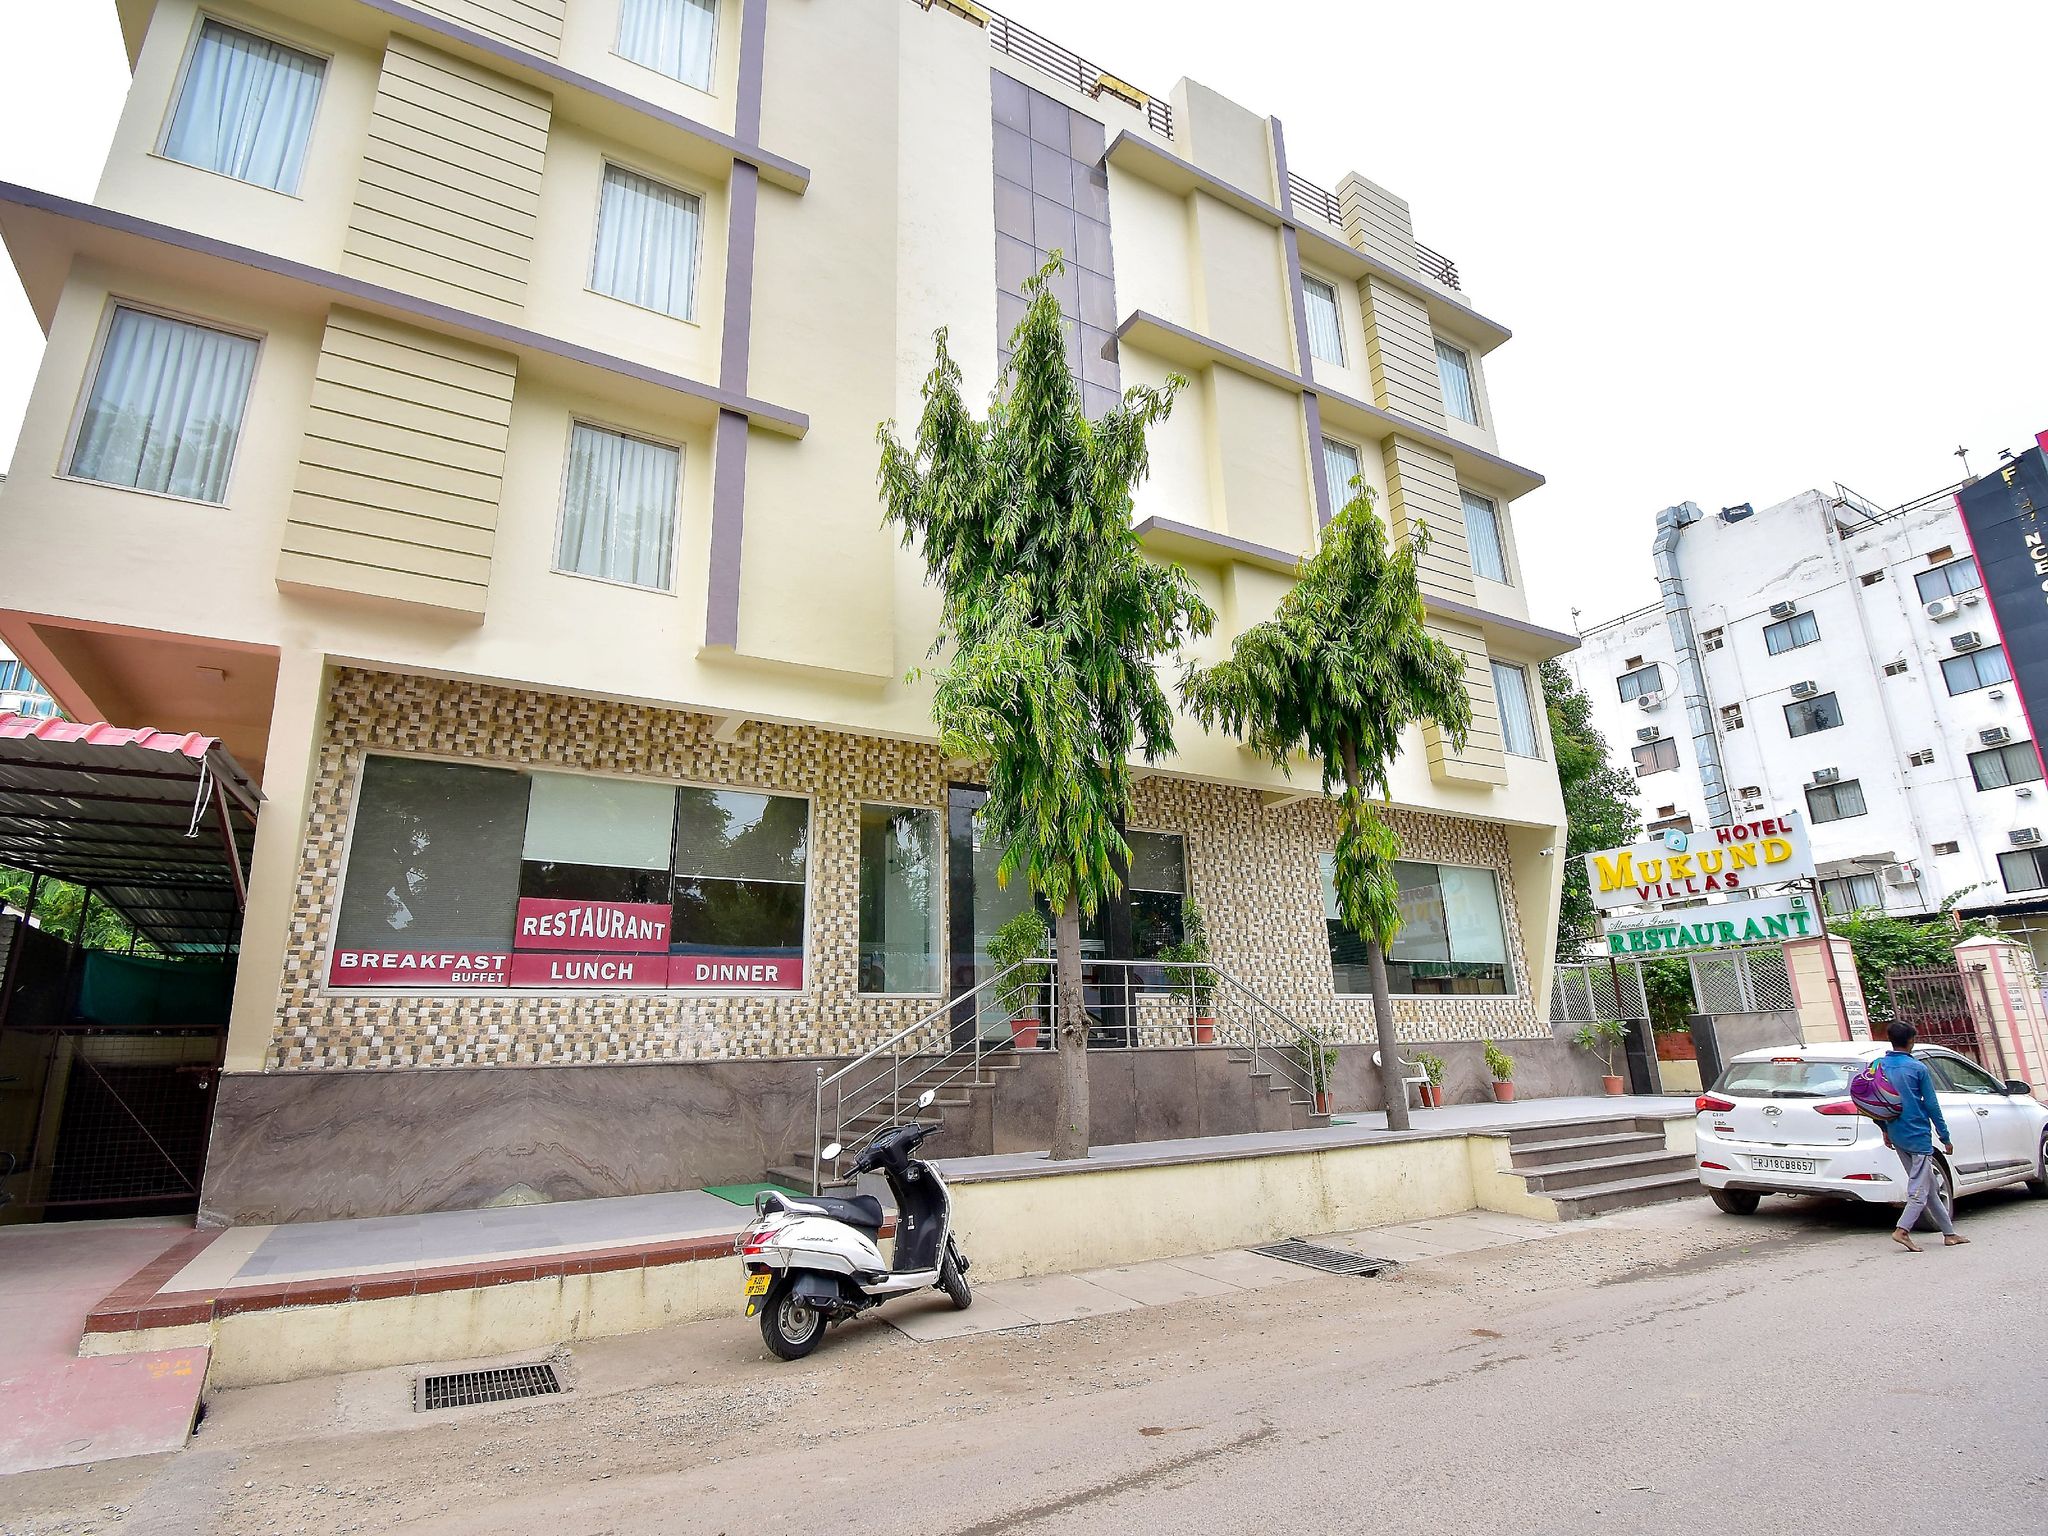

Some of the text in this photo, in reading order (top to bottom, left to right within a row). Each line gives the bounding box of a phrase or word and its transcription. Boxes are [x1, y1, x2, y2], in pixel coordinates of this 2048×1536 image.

[1716, 817, 1792, 844] HOTEL
[1593, 838, 1793, 892] MUKUND
[1636, 872, 1740, 901] VILLAS
[523, 906, 666, 941] RESTAURANT
[1607, 911, 1810, 955] RESTAURANT
[339, 953, 506, 971] BREAKFAST
[550, 962, 634, 981] LUNCH
[695, 963, 779, 982] DINNER
[451, 972, 504, 984] BUFFET
